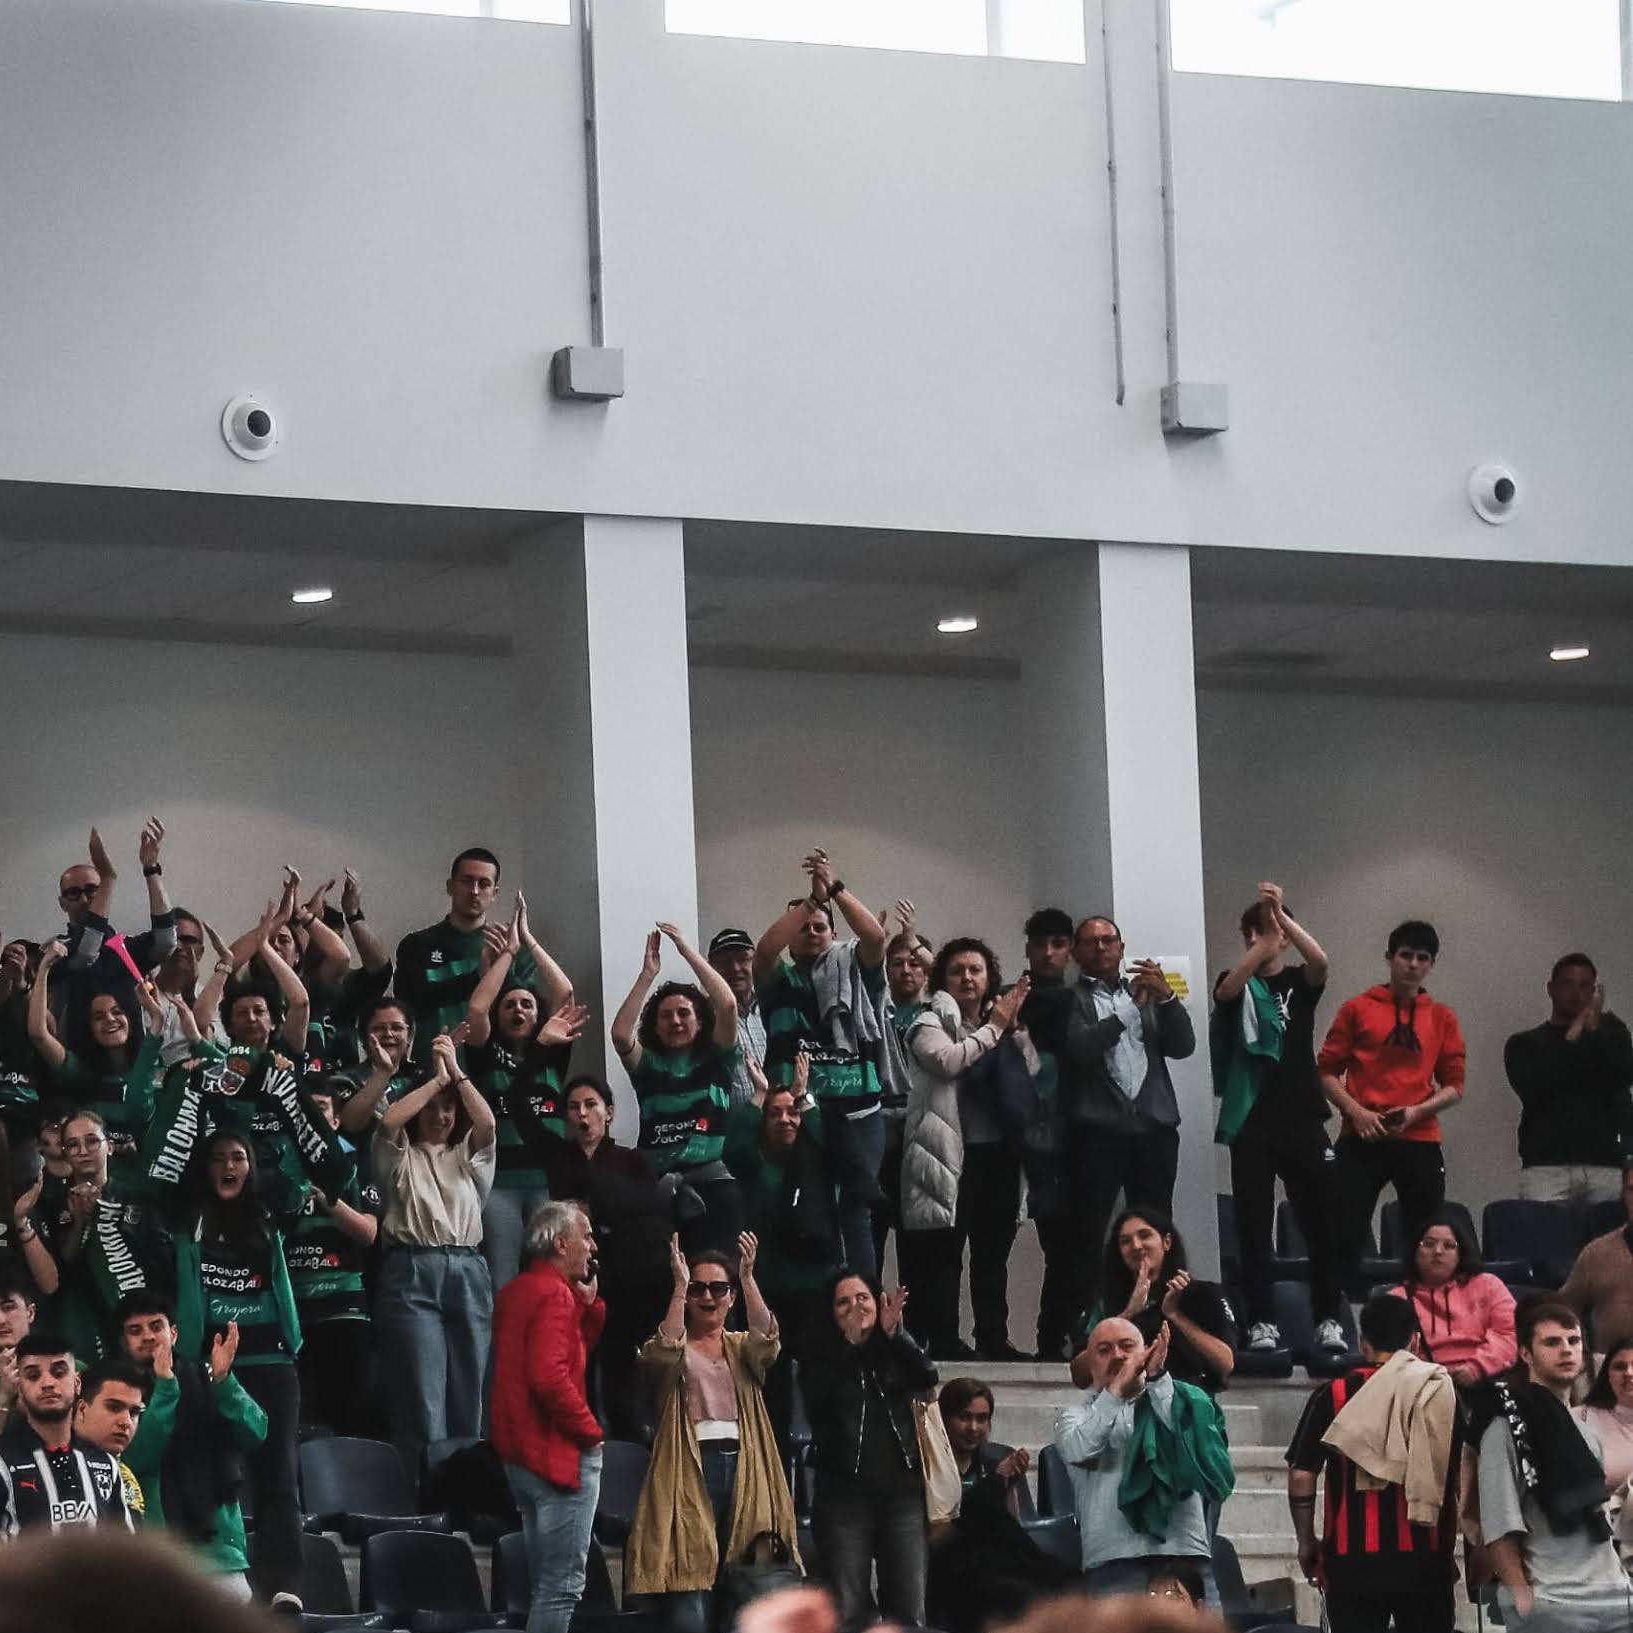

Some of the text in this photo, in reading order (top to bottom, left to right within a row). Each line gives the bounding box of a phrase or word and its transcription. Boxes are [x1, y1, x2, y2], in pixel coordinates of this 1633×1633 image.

[148, 1086, 204, 1185] BALONMA
[200, 1262, 251, 1278] EDONDO
[51, 1501, 97, 1523] BBVA
